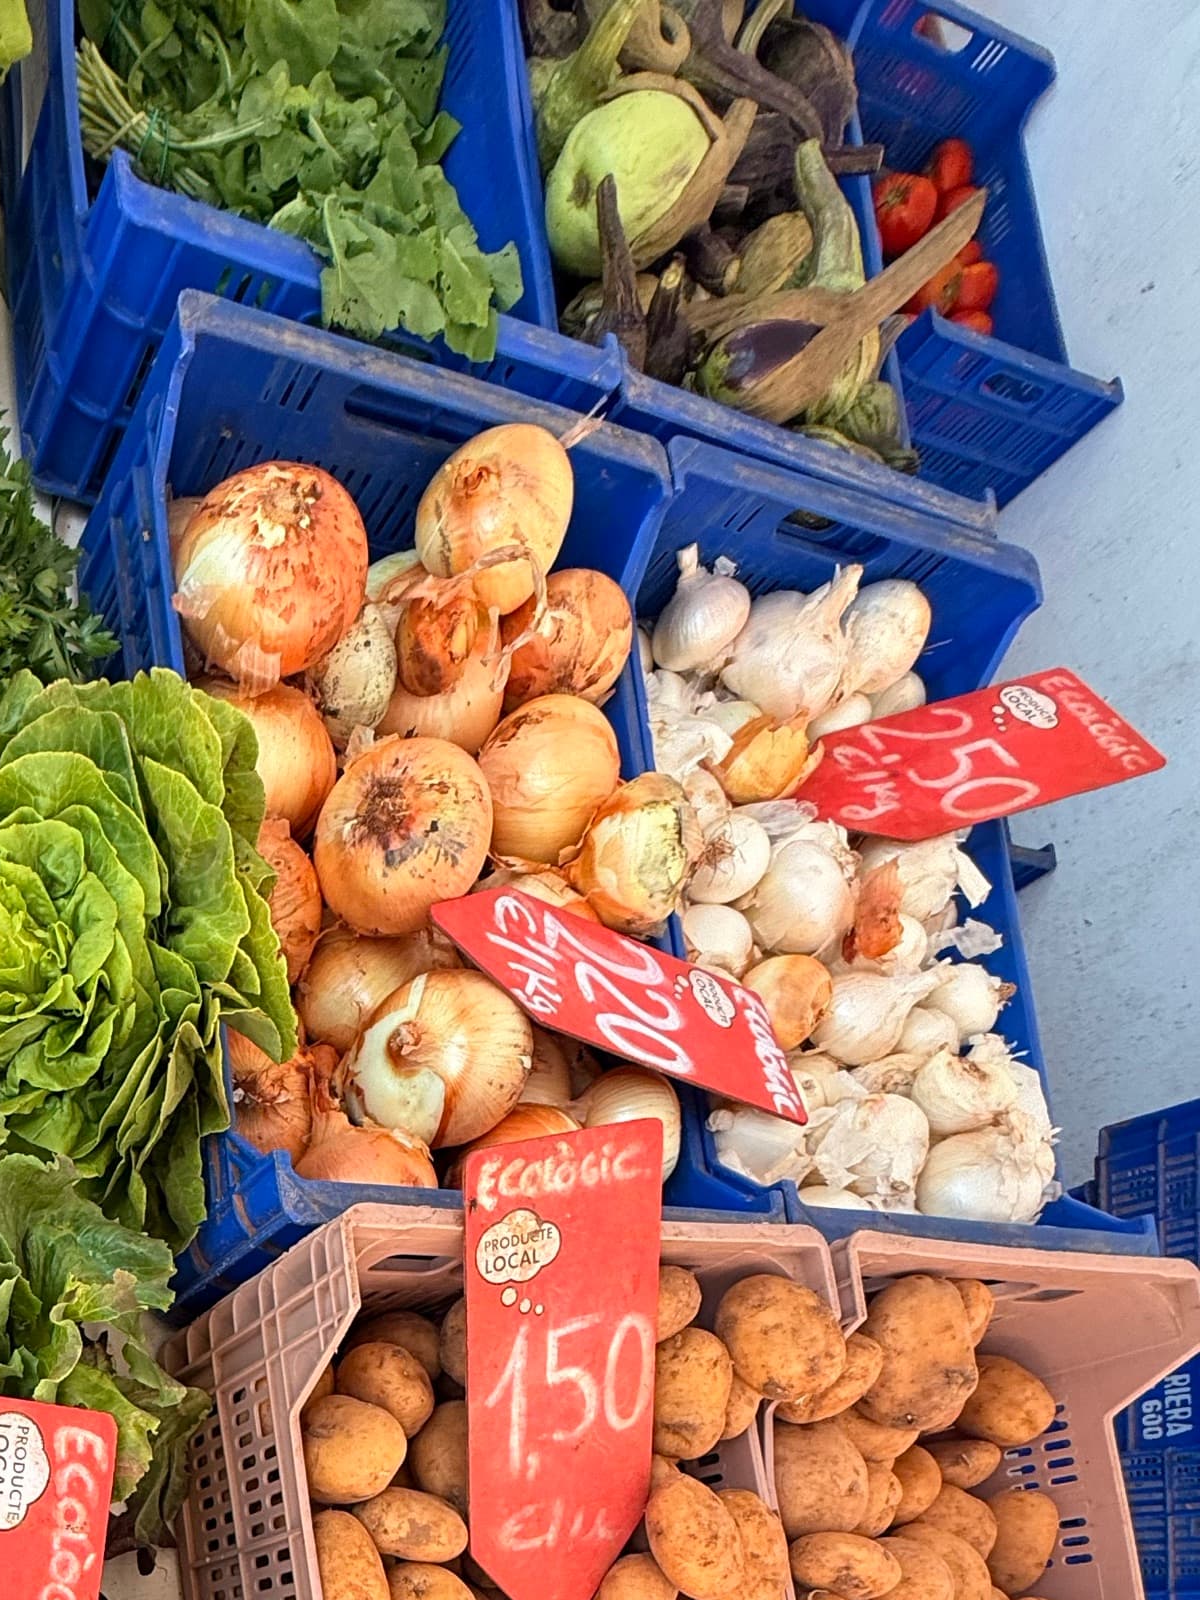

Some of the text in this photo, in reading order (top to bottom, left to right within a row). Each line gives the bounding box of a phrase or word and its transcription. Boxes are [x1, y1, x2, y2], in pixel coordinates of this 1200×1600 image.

[1003, 690, 1037, 721] LOCAL
[484, 1227, 554, 1252] PRODUCTE
[484, 1248, 541, 1275] LOCAL
[1141, 1399, 1164, 1440] 600
[1164, 1373, 1193, 1438] RIERA
[7, 1424, 30, 1521] PRODUCTE
